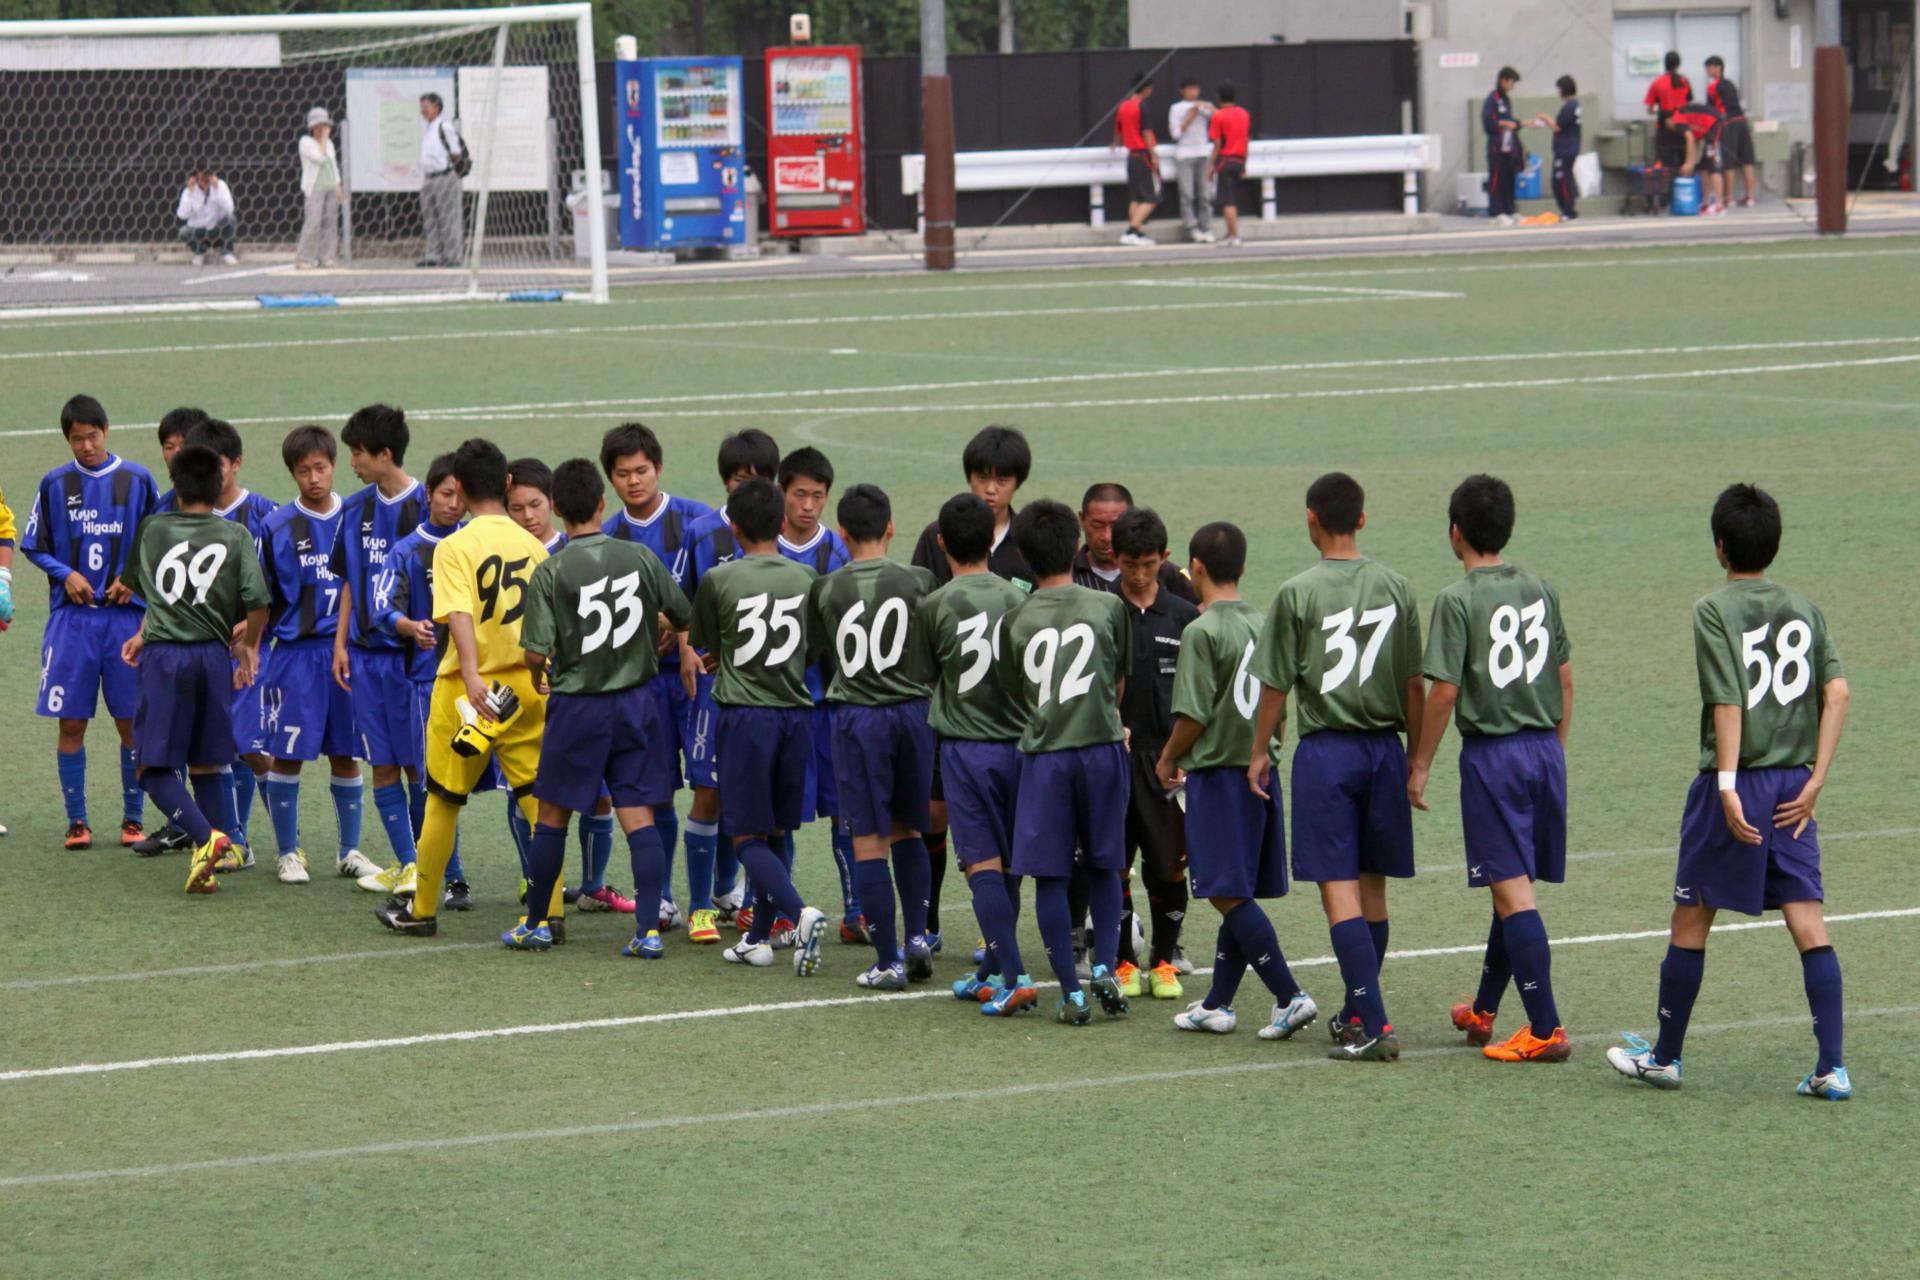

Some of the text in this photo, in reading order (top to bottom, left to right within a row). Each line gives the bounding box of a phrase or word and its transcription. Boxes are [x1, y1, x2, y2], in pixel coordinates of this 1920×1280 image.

[69, 509, 97, 521] Koyo
[83, 521, 123, 535] Higashi
[88, 543, 103, 571] 6
[155, 540, 228, 606] 69
[299, 554, 329, 568] Koyo
[476, 554, 531, 625] 95
[325, 589, 338, 616] 7
[577, 570, 644, 655] 53
[733, 592, 805, 667] 35
[835, 596, 909, 678] 60
[1024, 623, 1097, 708] 92
[1320, 603, 1397, 695] 37
[1488, 598, 1550, 689] 83
[1742, 619, 1813, 710] 58
[48, 685, 65, 712] 6
[284, 725, 301, 754] 7
